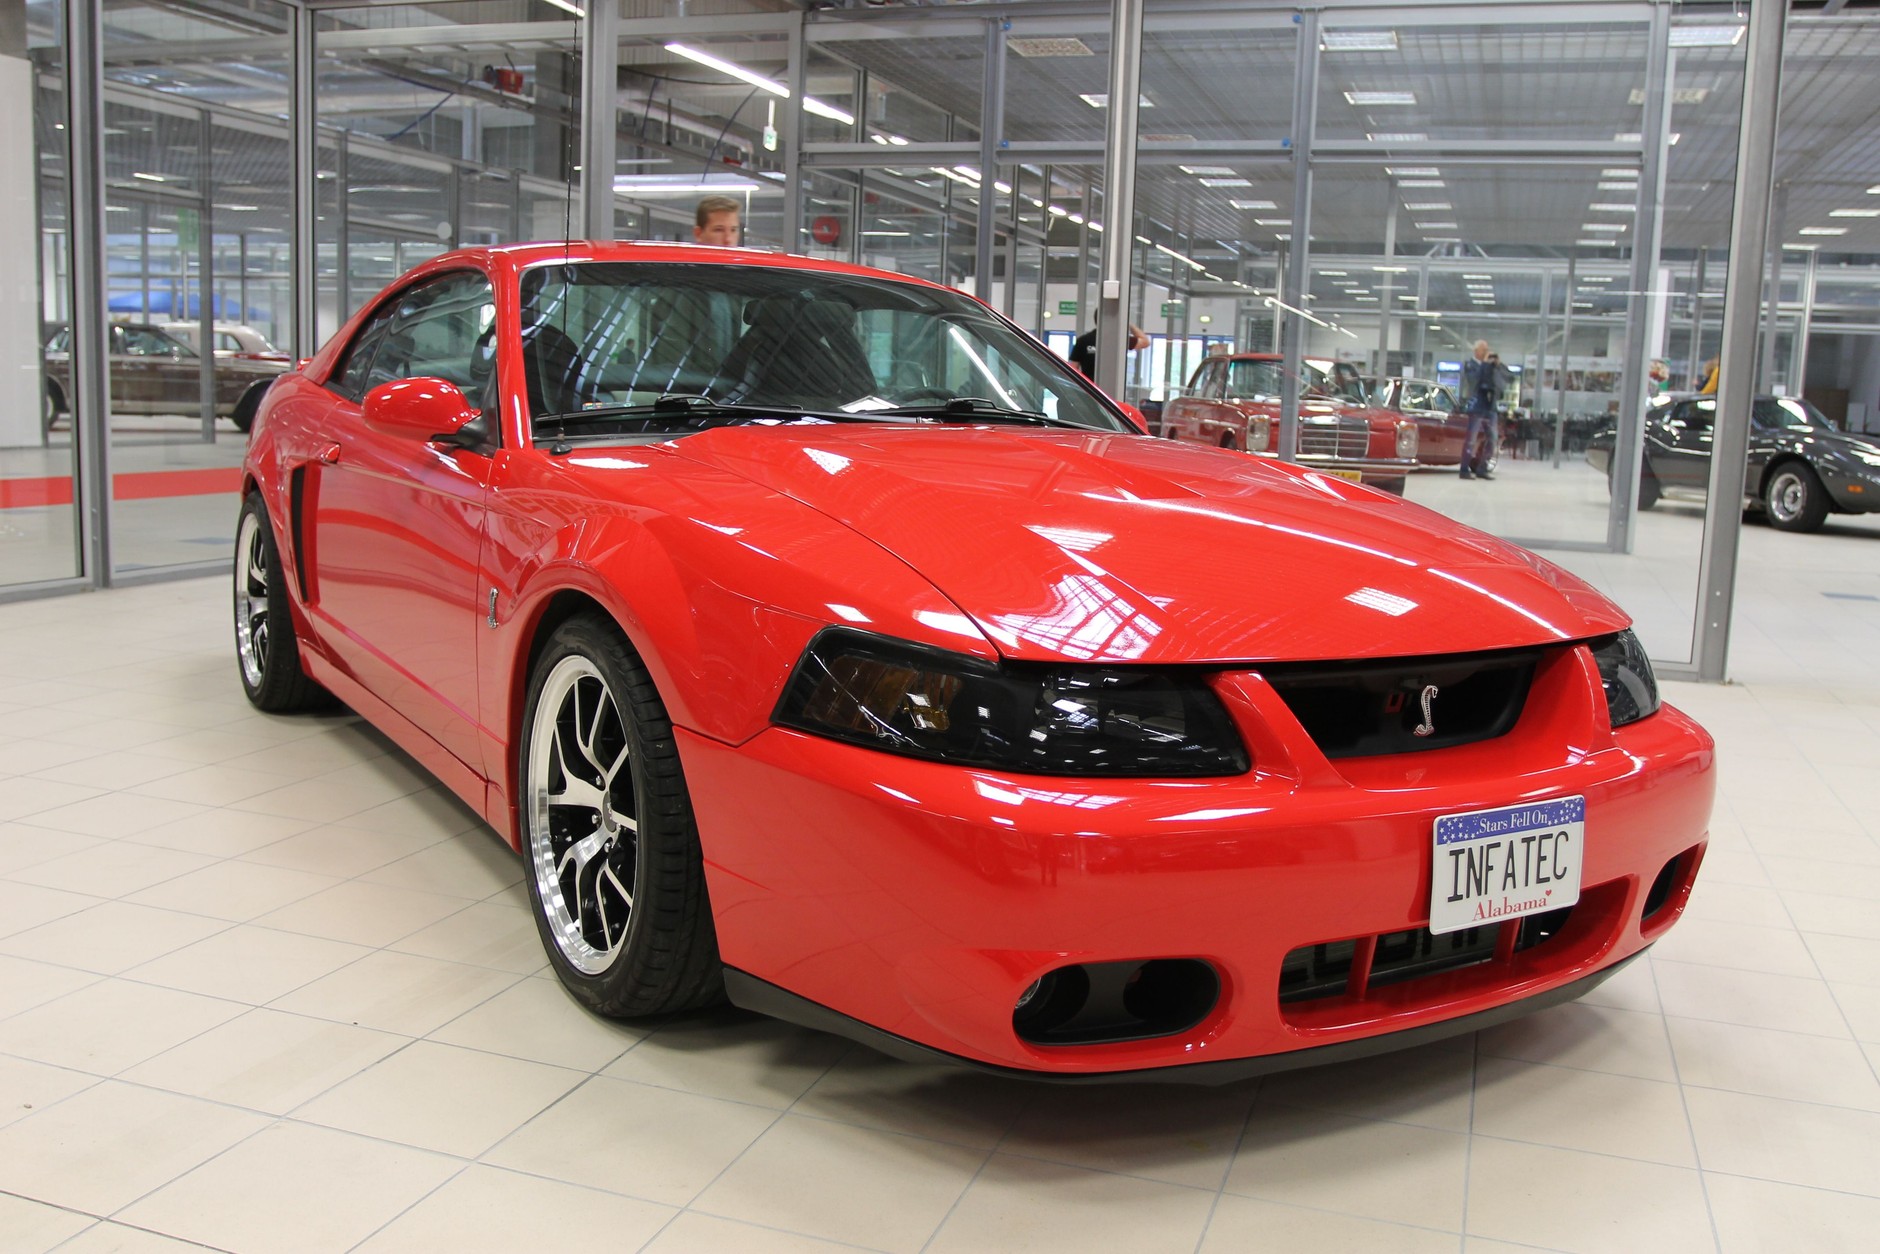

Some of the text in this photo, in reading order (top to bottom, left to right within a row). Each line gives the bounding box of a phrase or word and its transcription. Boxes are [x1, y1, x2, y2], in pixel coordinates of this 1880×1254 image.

[1479, 809, 1548, 833] Stars Fell On
[1447, 830, 1569, 903] INFATEC
[1472, 897, 1548, 921] Alabama
